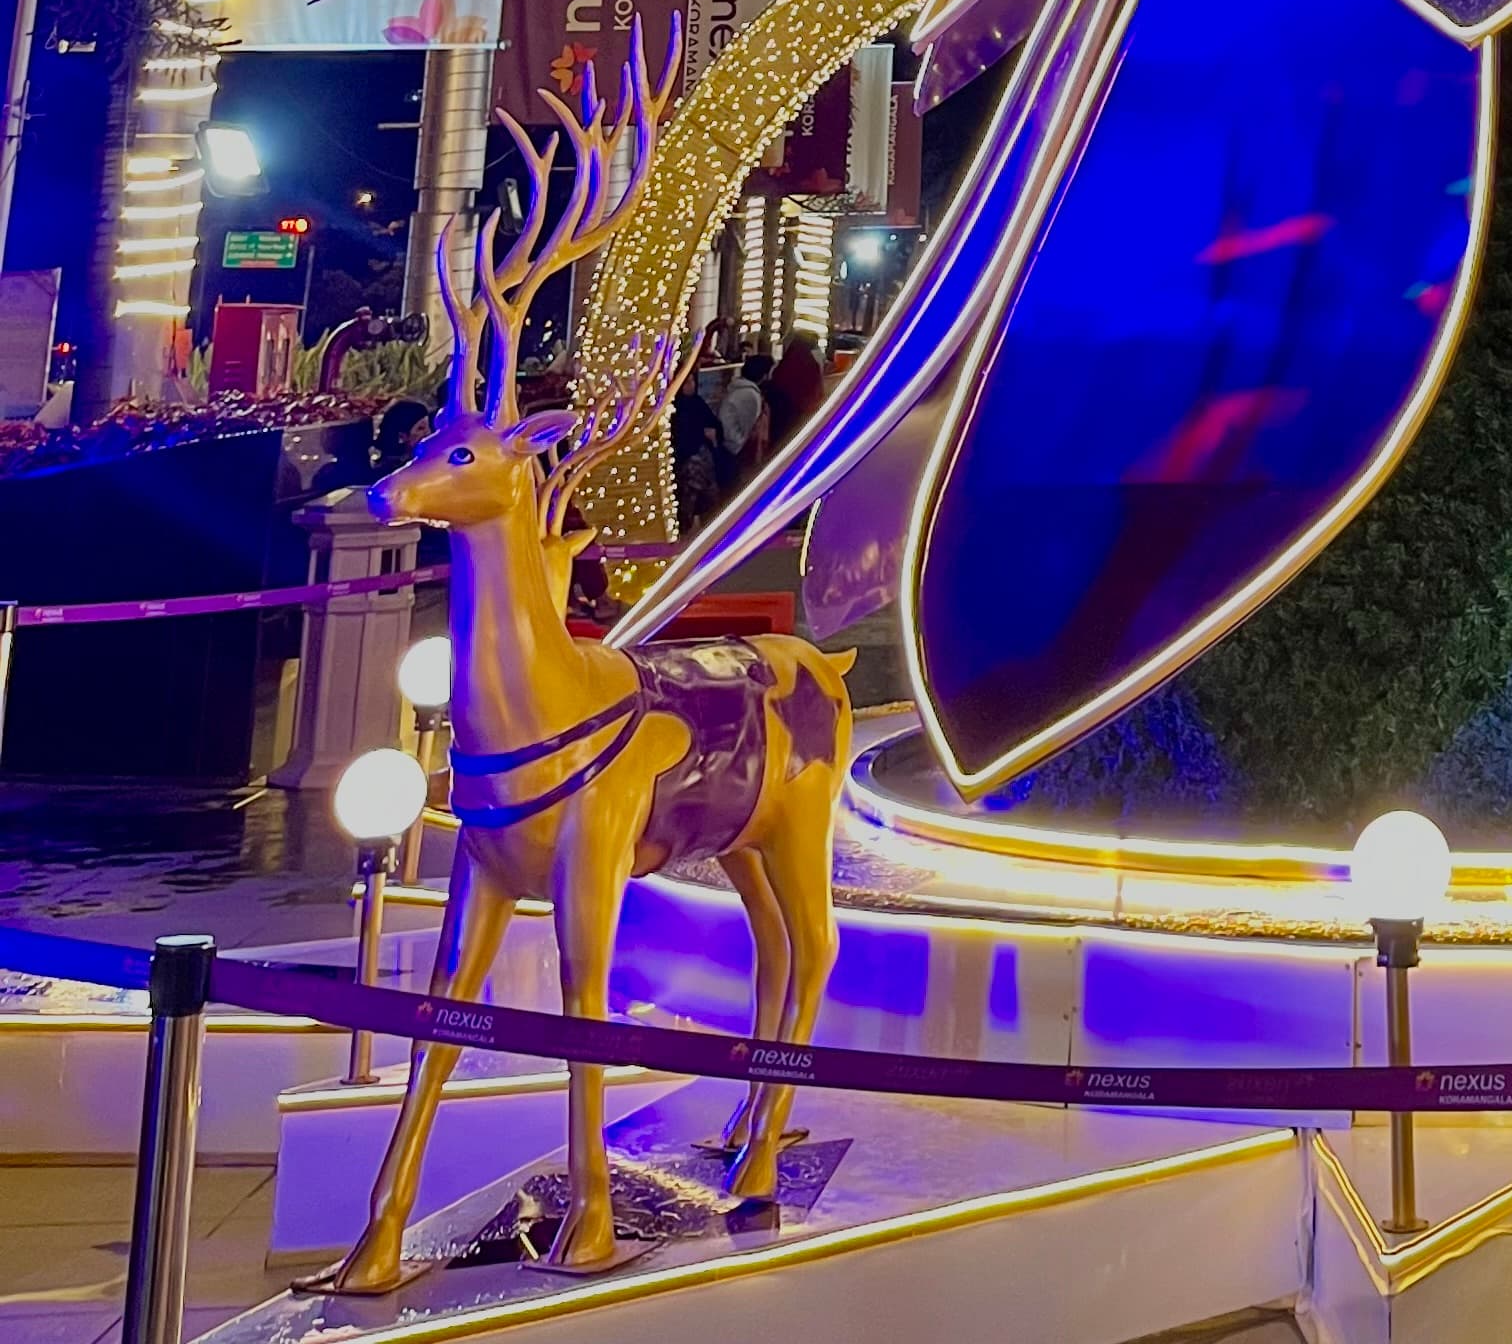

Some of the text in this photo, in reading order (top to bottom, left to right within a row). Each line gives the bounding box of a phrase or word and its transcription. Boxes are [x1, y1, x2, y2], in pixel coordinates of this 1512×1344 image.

[436, 1008, 494, 1031] nexus
[751, 1048, 813, 1068] nexus
[1087, 1072, 1151, 1089] nexus
[1439, 1073, 1506, 1091] nexus
